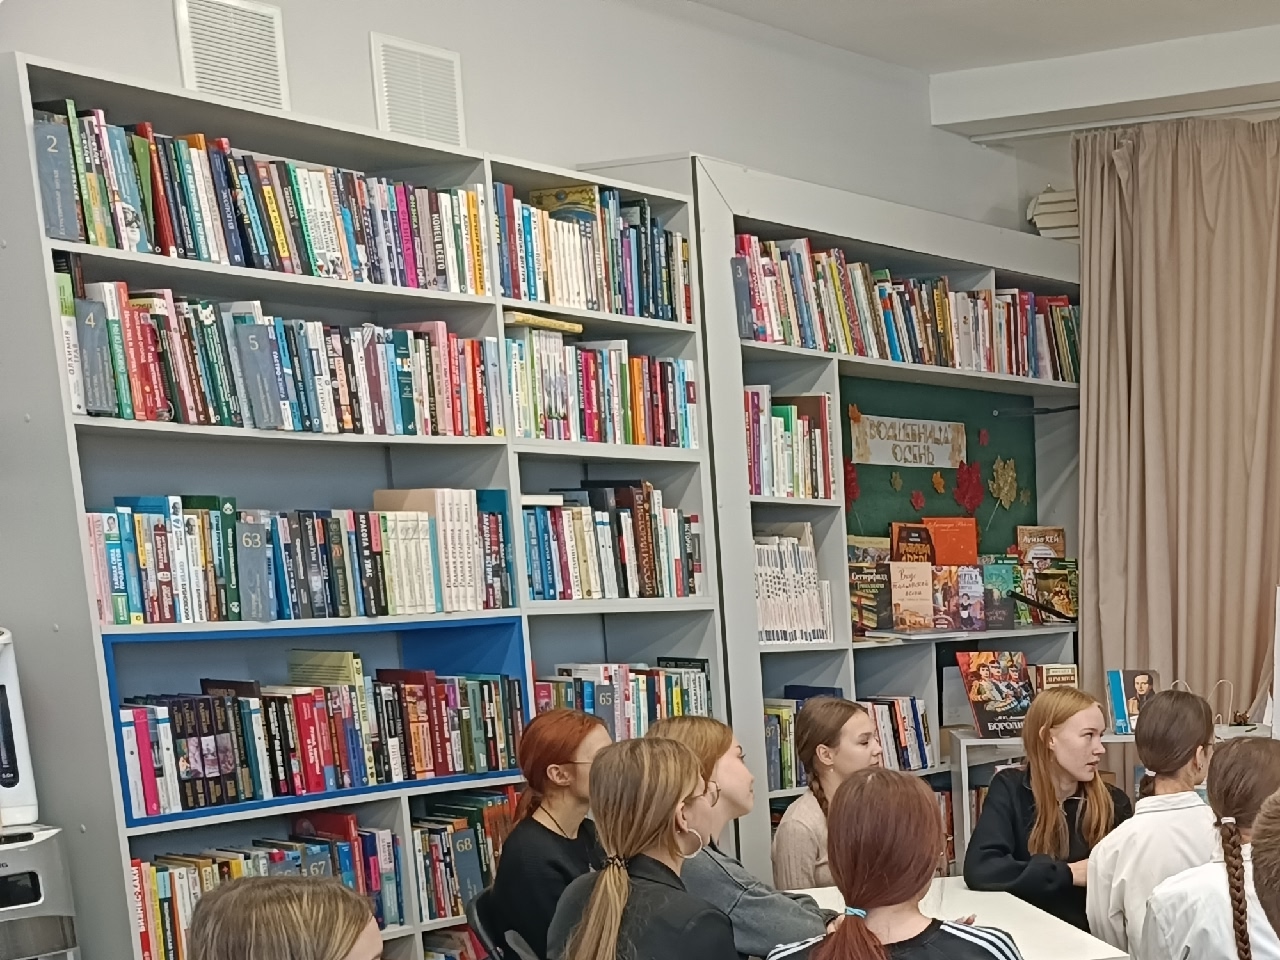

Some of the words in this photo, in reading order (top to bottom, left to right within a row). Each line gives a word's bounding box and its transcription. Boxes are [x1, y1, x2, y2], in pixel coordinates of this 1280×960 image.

[47, 136, 58, 153] 2
[329, 173, 341, 217] МАТЕМАТИКА
[222, 189, 234, 230] ЭКОЛОГИЯ
[432, 213, 442, 242] КОНЕЦ
[435, 244, 445, 269] ВСЕГО
[736, 265, 742, 278] 3
[85, 312, 96, 329] 4
[248, 335, 259, 350] 5
[317, 378, 327, 414] БУТЕЙКО
[429, 397, 438, 432] ВИРУС
[891, 443, 935, 465] ОСЕНЬ
[242, 533, 261, 548] 63
[359, 515, 369, 547] КРАСОТА
[364, 559, 373, 578] УЖАС
[116, 548, 125, 589] ПРОДУКТОВ
[642, 553, 652, 595] РОССИИ
[181, 583, 190, 621] БУБНОВСКИЙ
[599, 693, 612, 705] 65
[987, 721, 1024, 731] БОРОДИ
[456, 838, 473, 852] 68
[310, 861, 326, 875] 67
[131, 865, 146, 932] БИЗНЕС-ХАКИ
